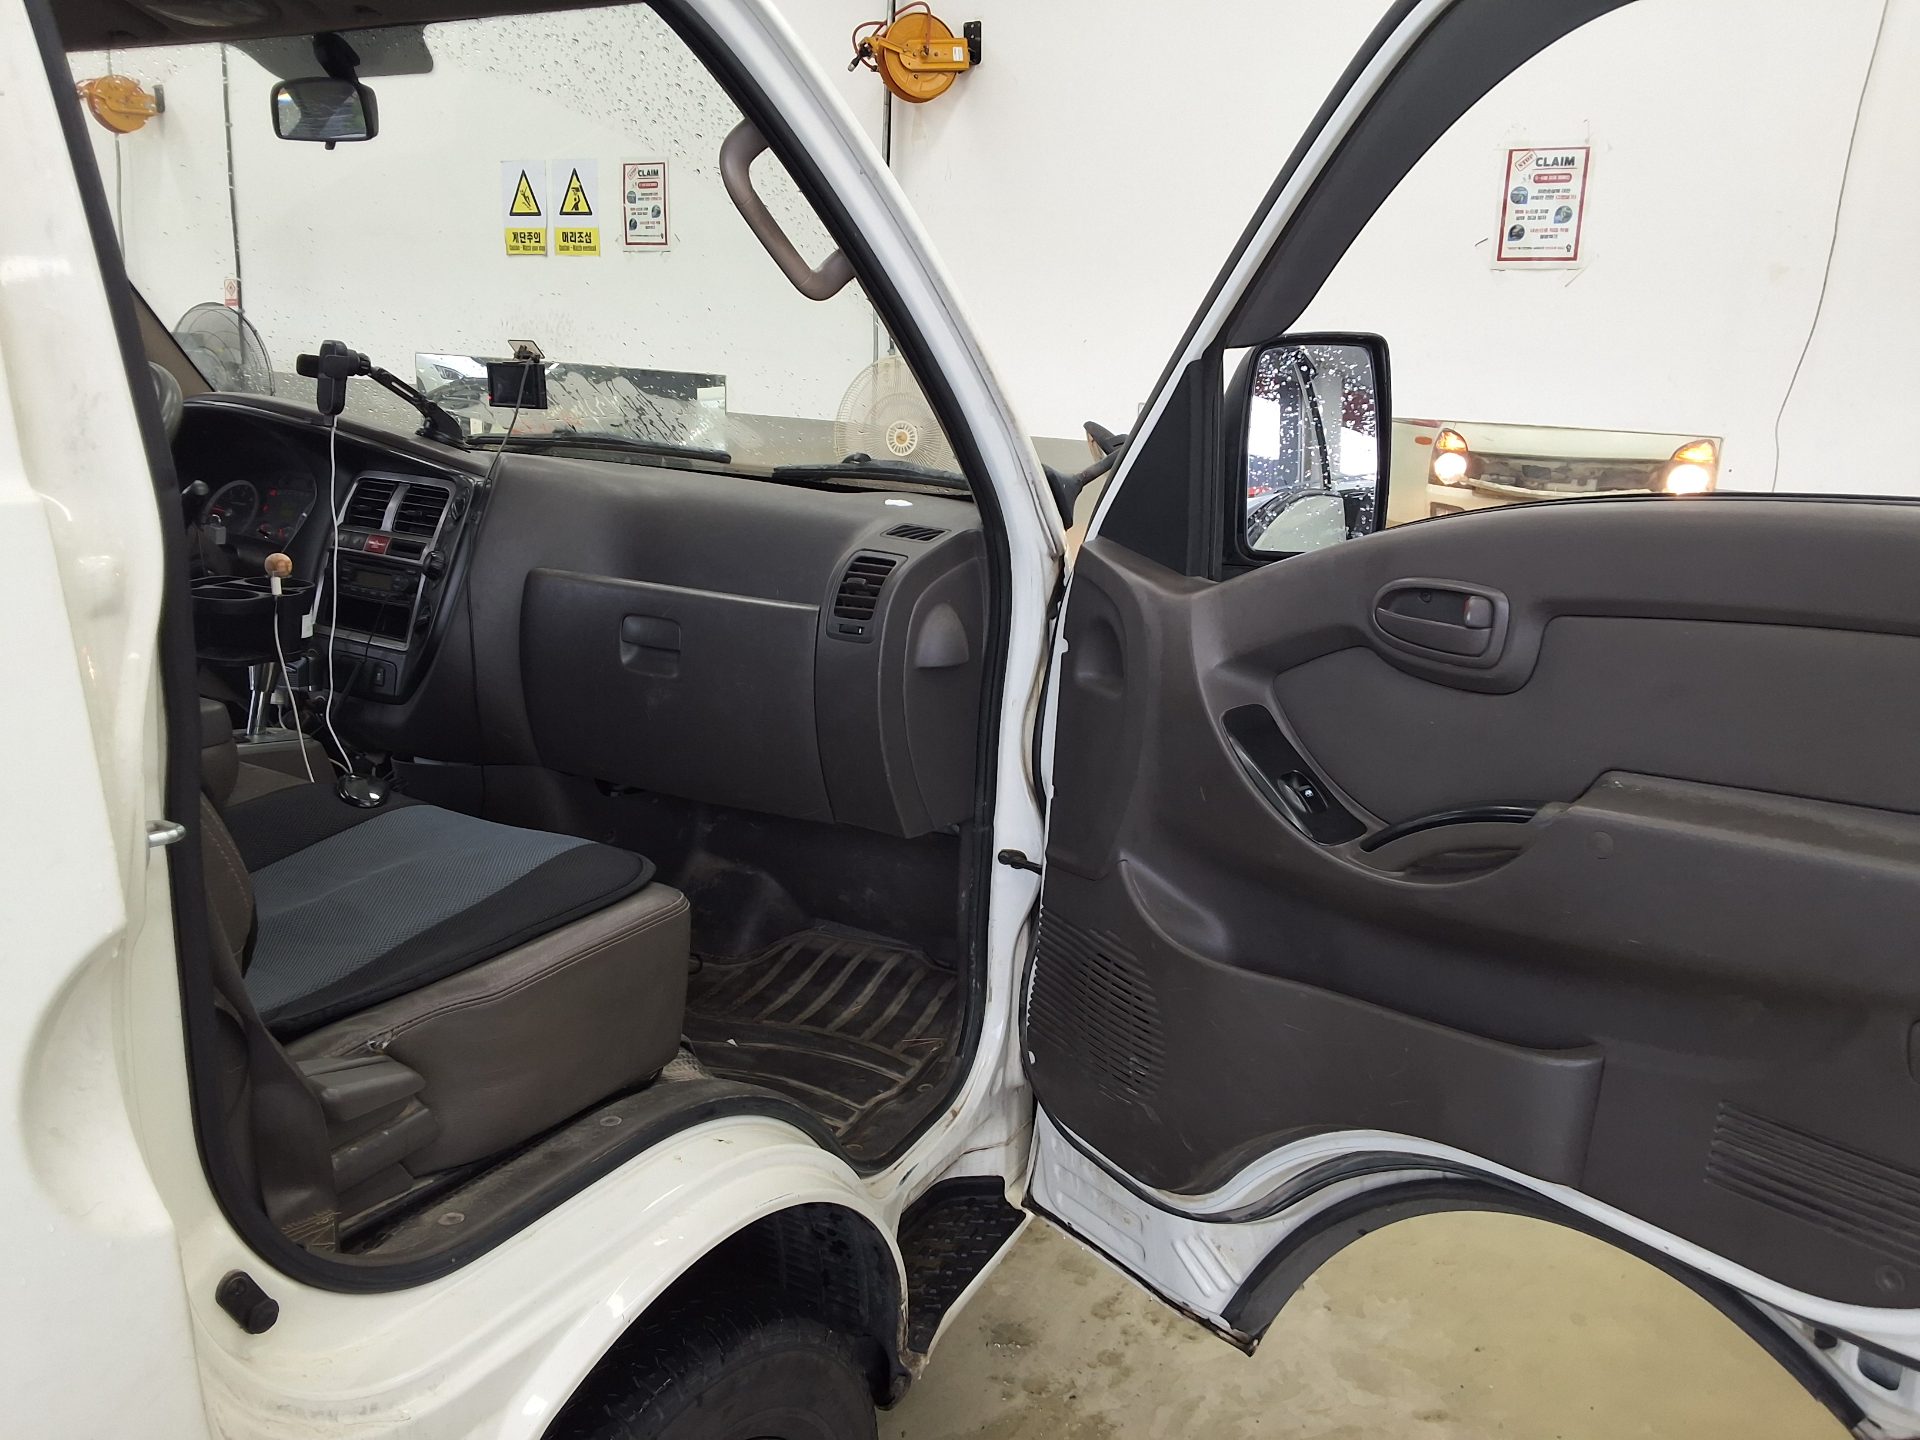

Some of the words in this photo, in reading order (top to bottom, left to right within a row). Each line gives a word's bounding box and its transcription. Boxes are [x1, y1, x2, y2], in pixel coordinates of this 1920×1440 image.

[1535, 156, 1575, 167] CLAIM
[638, 169, 659, 177] CLAIM
[512, 231, 541, 244] 계단주의
[562, 231, 592, 244] 머리조심
